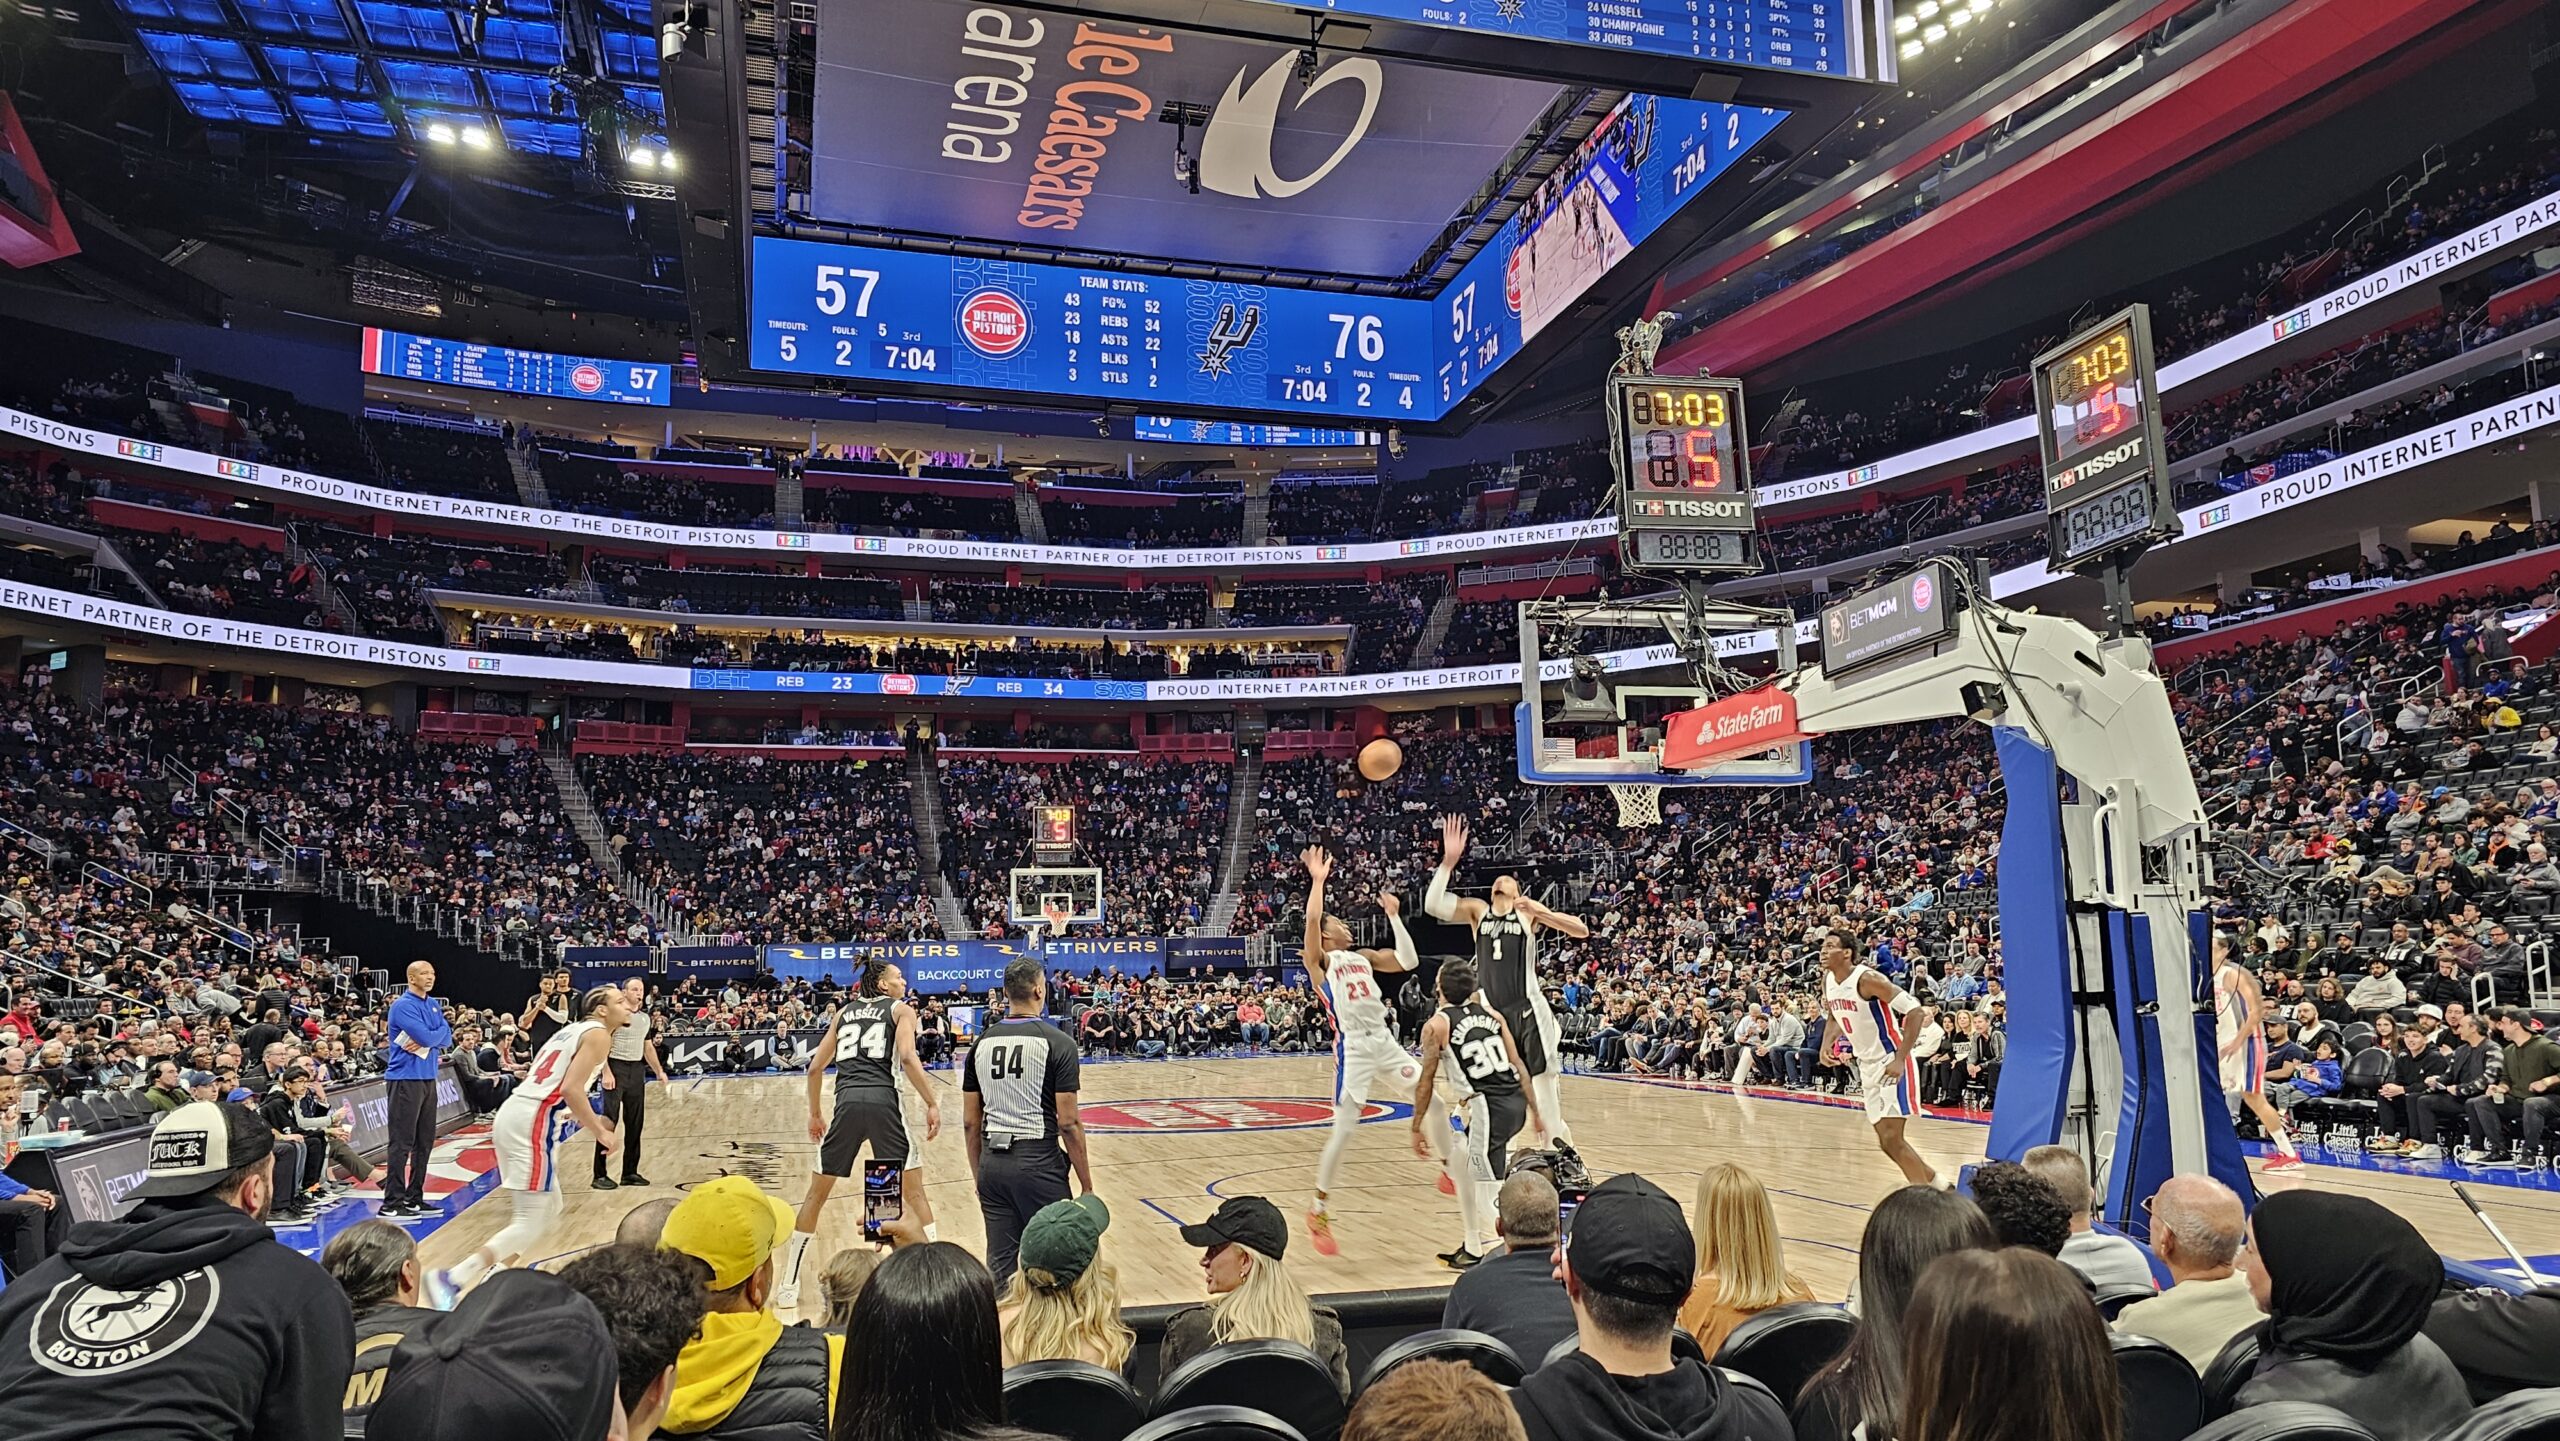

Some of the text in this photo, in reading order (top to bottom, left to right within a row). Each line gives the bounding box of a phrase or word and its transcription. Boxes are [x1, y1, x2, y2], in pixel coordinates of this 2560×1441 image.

[1423, 8, 1467, 25] FOULS: 2
[1587, 1, 1826, 31] 24 VASSELL 9 3 5 3PT% 33
[1686, 1, 1825, 15] 15 52
[1588, 17, 1826, 48] 30 CHAMPAGNIE 2 4 2 FT% 77
[1588, 31, 1827, 60] 33 JONES 9 2 3 OREB 8
[1771, 55, 1828, 72] DREB 26
[941, 8, 1045, 163] arena
[1681, 112, 1740, 152] 3rd 5 2
[1017, 80, 1152, 230] Caesars
[1672, 144, 1706, 195] 7:04
[2324, 225, 2502, 317] PROUD INTERNET
[816, 265, 880, 318] 57
[1080, 276, 1149, 293] TEAM STATS:
[1064, 293, 1160, 314] 43 FG% 52
[1452, 281, 1476, 343] 57
[972, 309, 1017, 324] DETROIT
[1064, 312, 1160, 332] 23 REBS 34
[768, 320, 921, 341] TIMEOUTS: FOULS: 5 3rd
[972, 320, 1017, 336] PISTONS
[1328, 313, 1384, 362] 76
[1064, 331, 1160, 351] 18 ASTS 22
[780, 335, 936, 372] 5 2 7:04
[1069, 349, 1157, 369] 2 BLKS 1
[2072, 335, 2129, 386] 7:03
[629, 367, 658, 389] 57
[1069, 368, 1157, 387] 3 STLS 2
[1295, 361, 1421, 382] 3rd 5 FOULS: TIMEOUTS:
[1443, 376, 1450, 402] 5
[1461, 360, 1468, 387] 2
[1478, 333, 1498, 370] 7:04
[1282, 378, 1413, 410] 7:04 2 4
[1655, 392, 1725, 427] 7:03
[2097, 382, 2121, 433] 5
[10, 414, 95, 447] PISTONS
[1686, 429, 1721, 488] 5
[2074, 437, 2143, 481] TISSOT
[2261, 472, 2332, 509] PROUD
[2344, 430, 2457, 481] INTERNET
[1774, 477, 1840, 500] PISTONS
[281, 474, 756, 545] PROUD INTERNET PARTNER OF THE DETROIT PISTONS
[1663, 501, 1745, 518] TISSOT
[1436, 528, 1564, 551] PROUD INTERNET
[907, 542, 1302, 564] PROUD INTERNET PARTNER OF THE DETROIT PISTONS
[1850, 597, 1898, 630] BETMGM
[82, 604, 446, 667] PARTNER OF THE DETROIT PISTONS
[776, 676, 853, 690] REB 23
[996, 682, 1063, 695] REB 34
[1158, 669, 1503, 696] PROUD INTERNET PARTNER OF THE DETROIT
[1046, 809, 1071, 822] 7:03
[1054, 821, 1066, 841] 5
[1045, 941, 1158, 955] ETRIVERS
[1186, 949, 1244, 957] BETRIVERS
[1492, 939, 1503, 960] 1
[586, 960, 648, 968] BETRIVERS
[690, 958, 756, 967] BETRIVERS
[917, 970, 992, 981] BACKCOURT
[1346, 980, 1371, 1001] 23
[842, 1006, 885, 1022] VASSELL
[1829, 999, 1858, 1012] PISTONS
[1451, 1013, 1502, 1045] CHAMPAGNIE
[1842, 1016, 1853, 1034] 0
[836, 1022, 887, 1062] 24
[533, 1049, 563, 1084] 4
[991, 1045, 1024, 1080] 94
[1461, 1034, 1510, 1080] 30
[2323, 1132, 2362, 1148] Caesars
[2332, 1122, 2358, 1138] Little
[151, 1141, 201, 1162] FUCK
[45, 1339, 151, 1368] BOSTON
